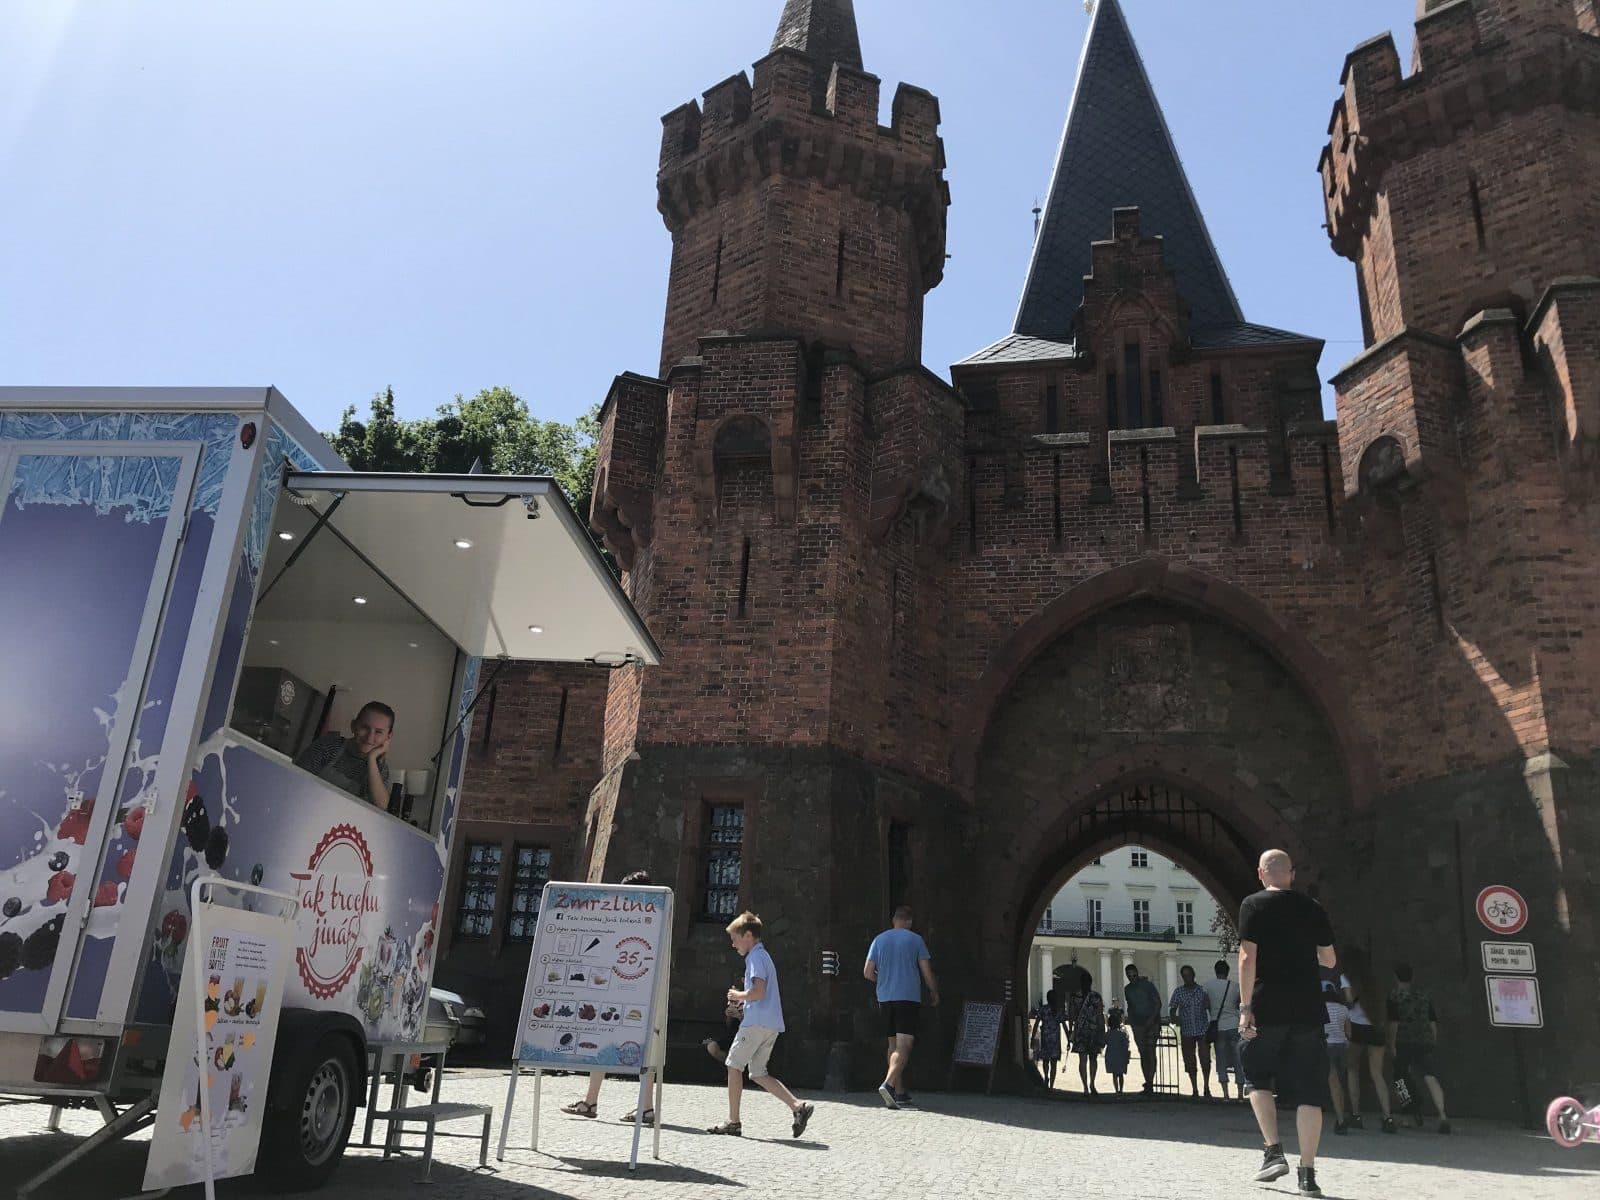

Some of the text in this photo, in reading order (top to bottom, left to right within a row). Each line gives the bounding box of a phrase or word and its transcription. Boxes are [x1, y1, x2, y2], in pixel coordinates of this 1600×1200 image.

[290, 872, 379, 917] Tak trochu
[554, 893, 656, 913] Zmrzlina
[212, 936, 229, 949] FRUIT
[309, 917, 352, 958] jiná
